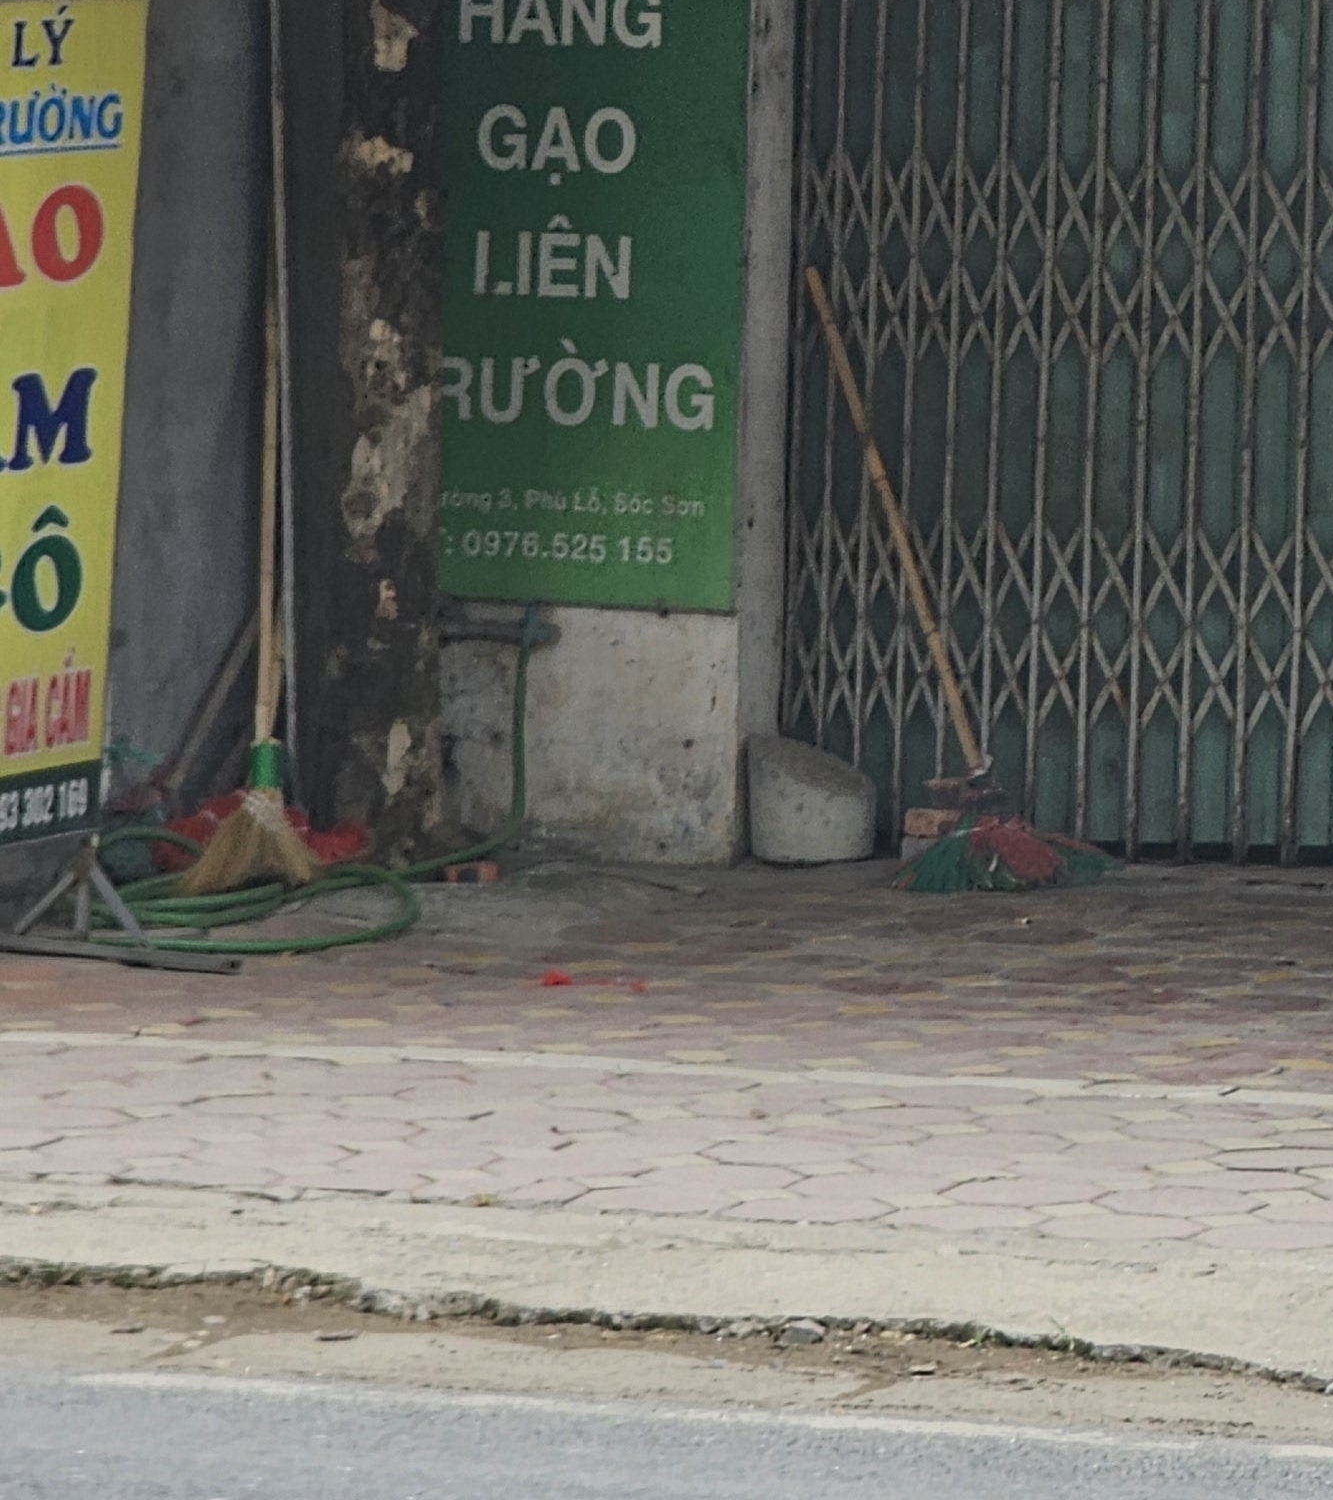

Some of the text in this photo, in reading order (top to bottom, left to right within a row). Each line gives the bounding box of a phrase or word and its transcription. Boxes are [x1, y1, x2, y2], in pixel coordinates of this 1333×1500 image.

[12, 5, 75, 68] LÝ
[476, 104, 637, 186] GẠO
[473, 214, 633, 300] LIÊN
[441, 338, 715, 431] RƯỜNG
[461, 529, 607, 564] 0976.525
[618, 536, 674, 565] 155
